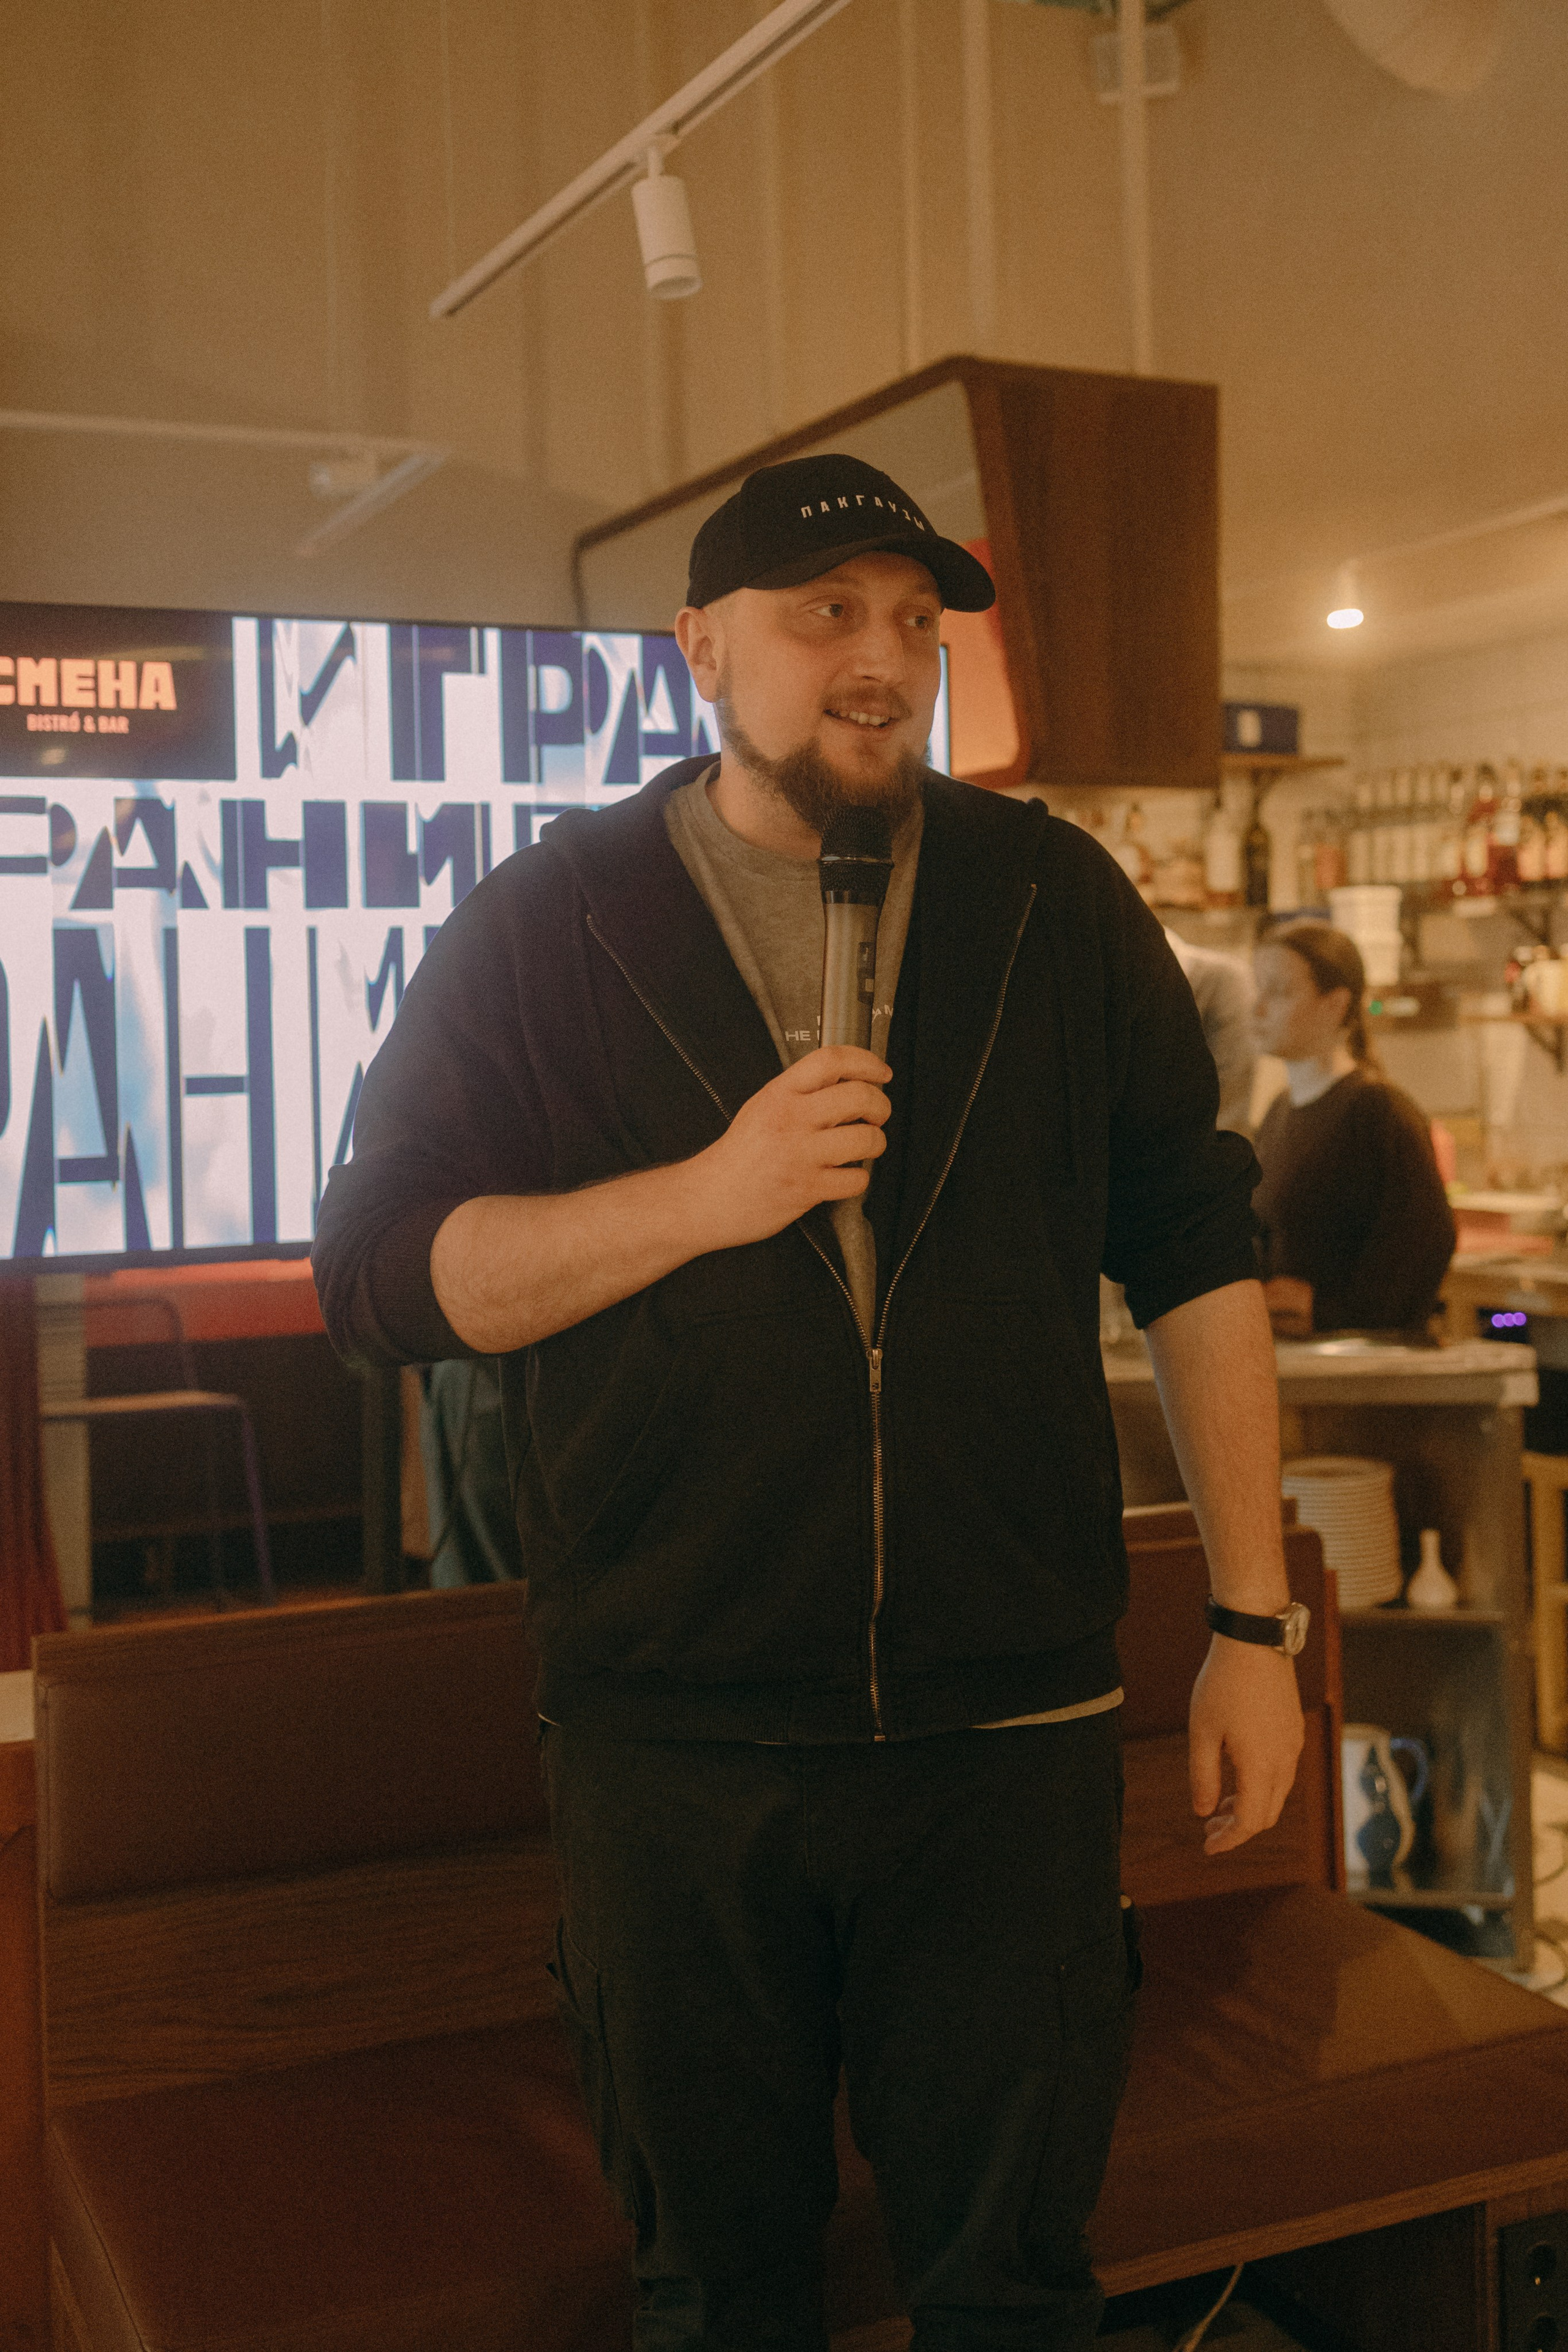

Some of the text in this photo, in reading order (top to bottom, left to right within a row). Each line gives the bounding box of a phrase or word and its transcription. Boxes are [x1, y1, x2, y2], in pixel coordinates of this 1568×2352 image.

[801, 495, 925, 531] ПАКГАУЗЫ
[84, 715, 96, 733] &
[99, 715, 129, 734] BAR
